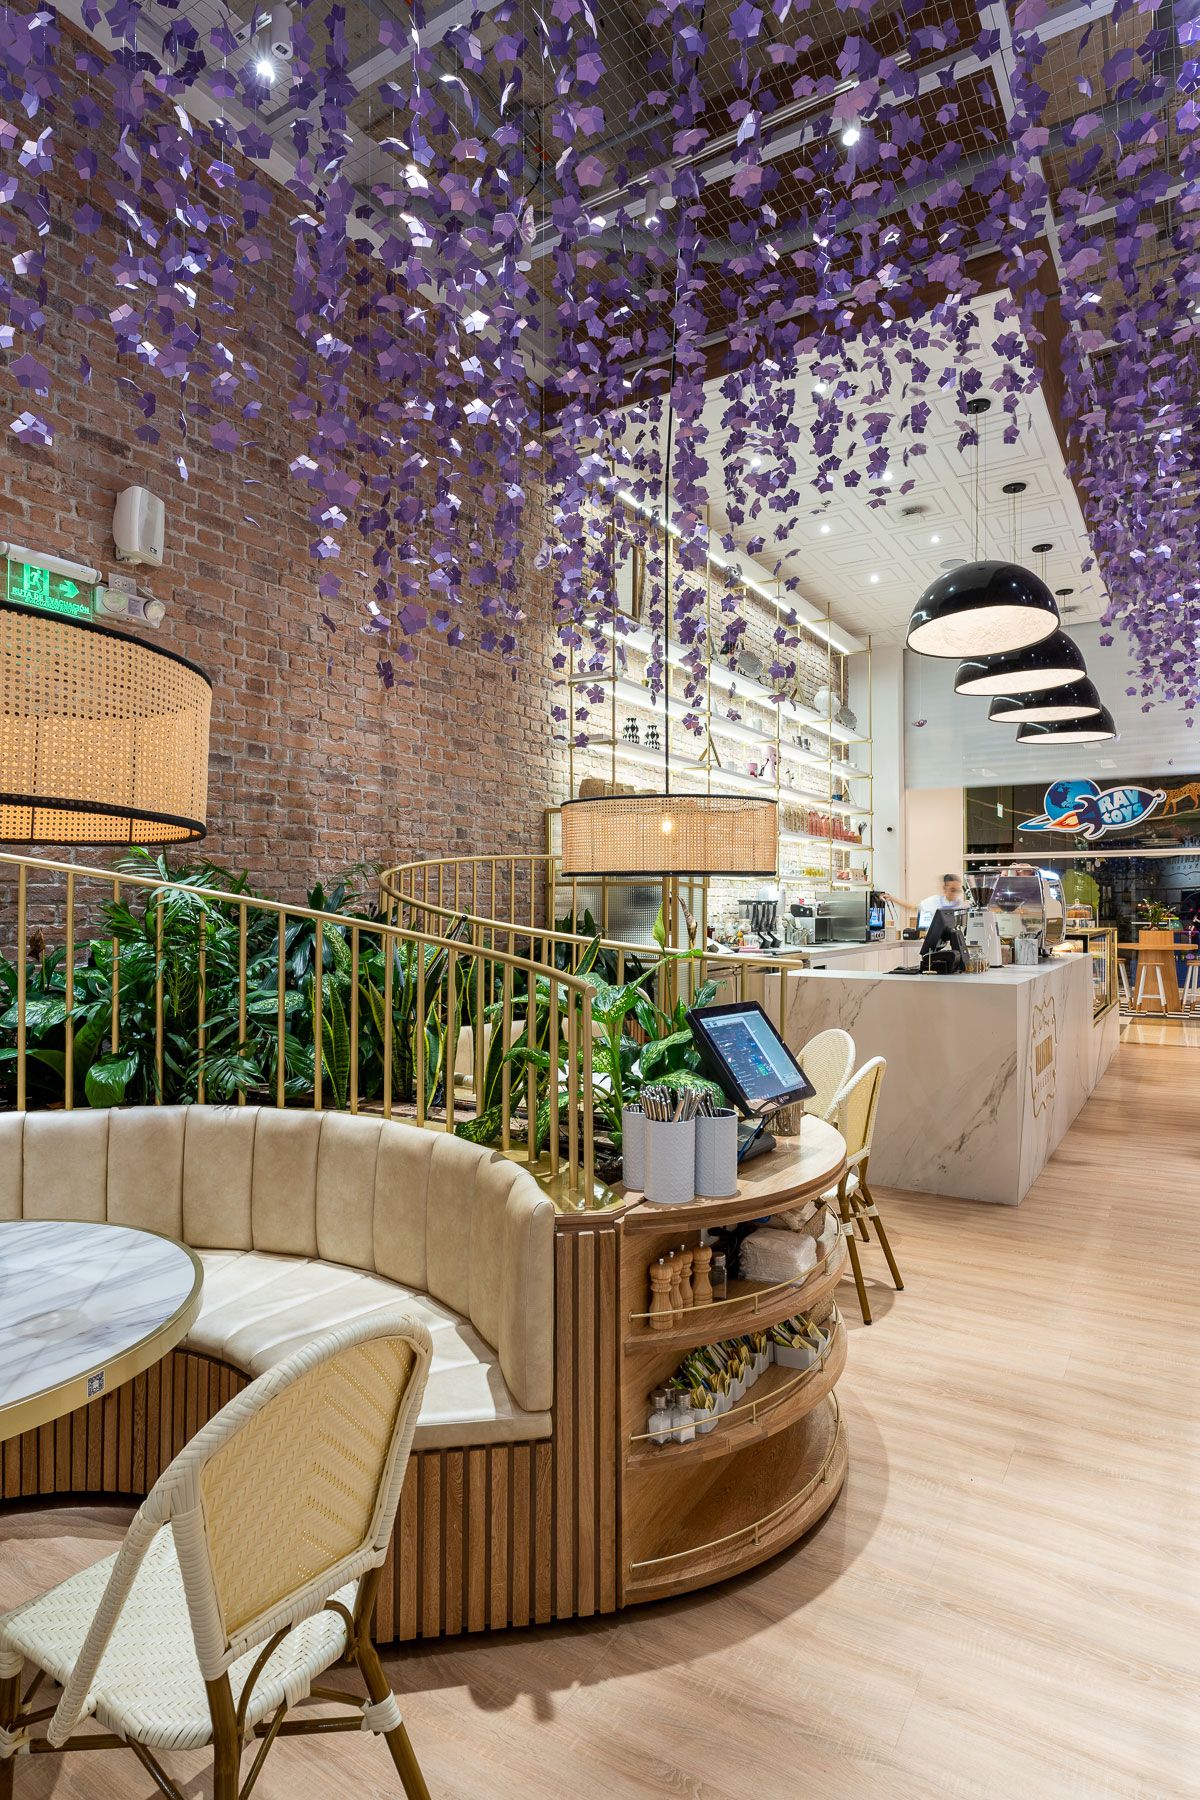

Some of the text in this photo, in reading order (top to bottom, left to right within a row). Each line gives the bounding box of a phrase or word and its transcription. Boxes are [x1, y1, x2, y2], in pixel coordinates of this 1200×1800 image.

[11, 586, 90, 615] RUTA DE EVACUACIÓN
[1097, 789, 1139, 814] RAV
